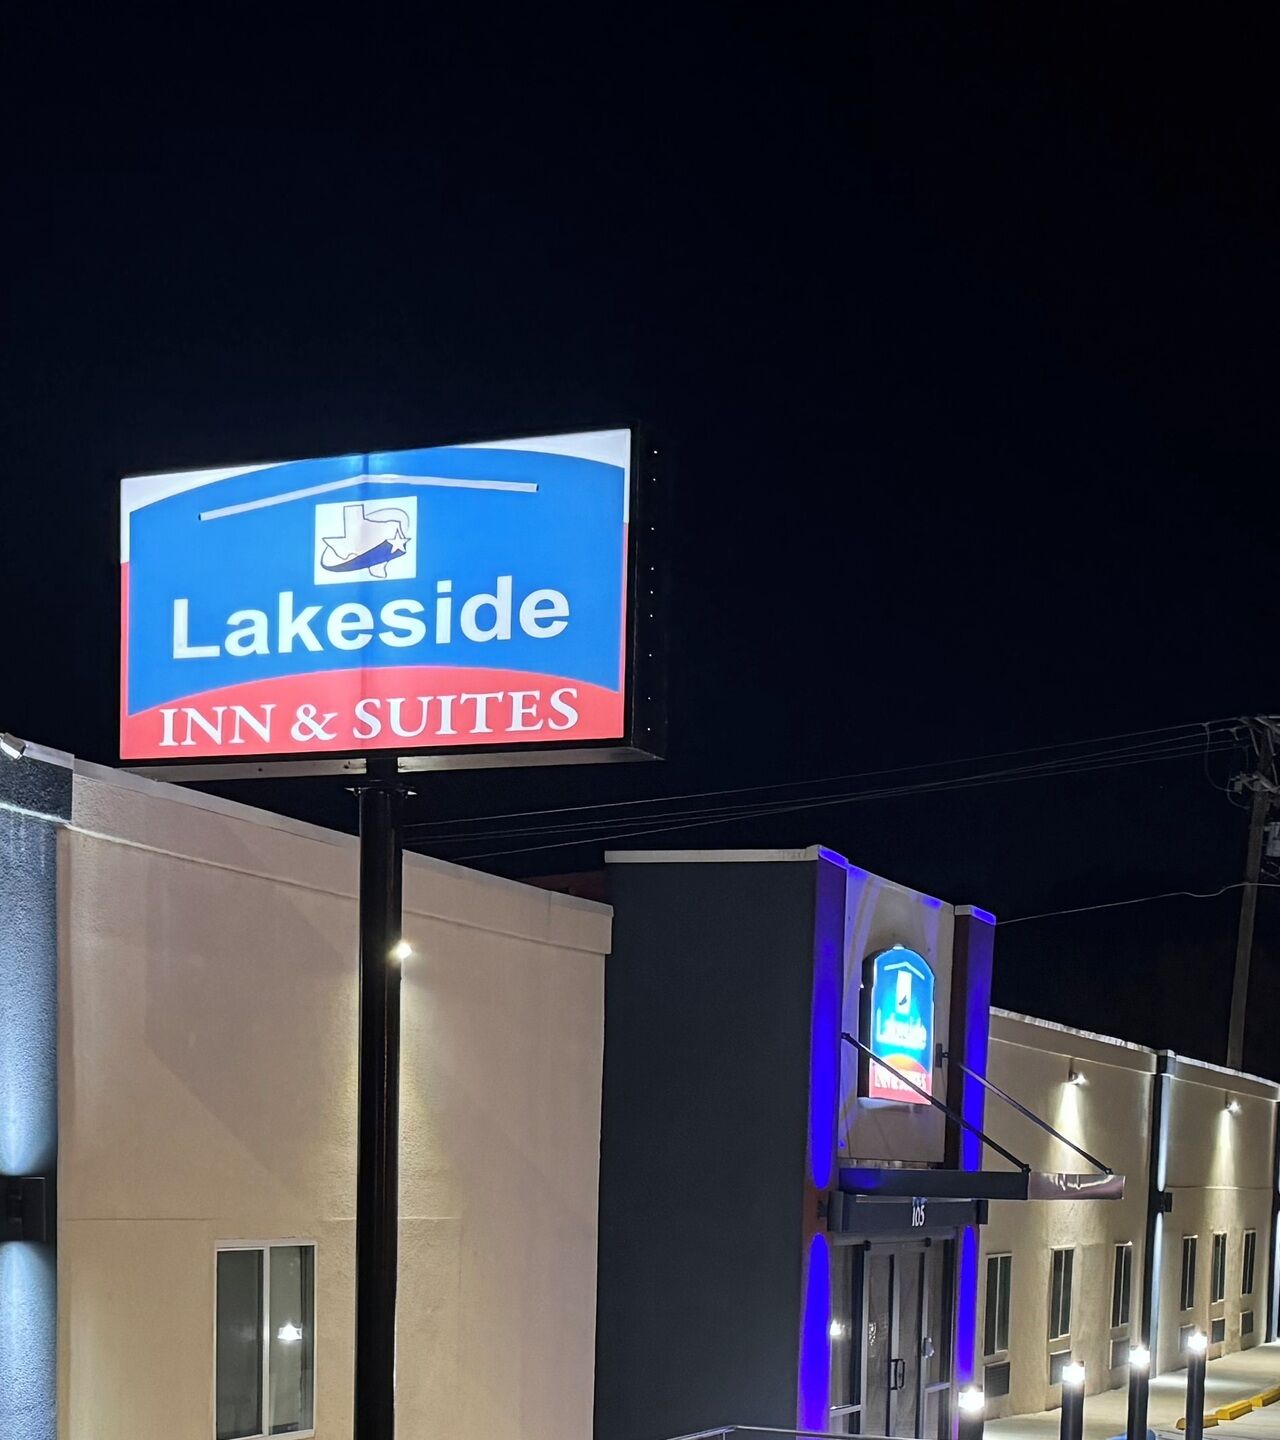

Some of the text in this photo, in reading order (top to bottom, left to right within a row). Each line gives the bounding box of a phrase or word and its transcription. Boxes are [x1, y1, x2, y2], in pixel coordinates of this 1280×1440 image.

[173, 575, 570, 659] Lakeside
[158, 687, 580, 748] INN & SUITES
